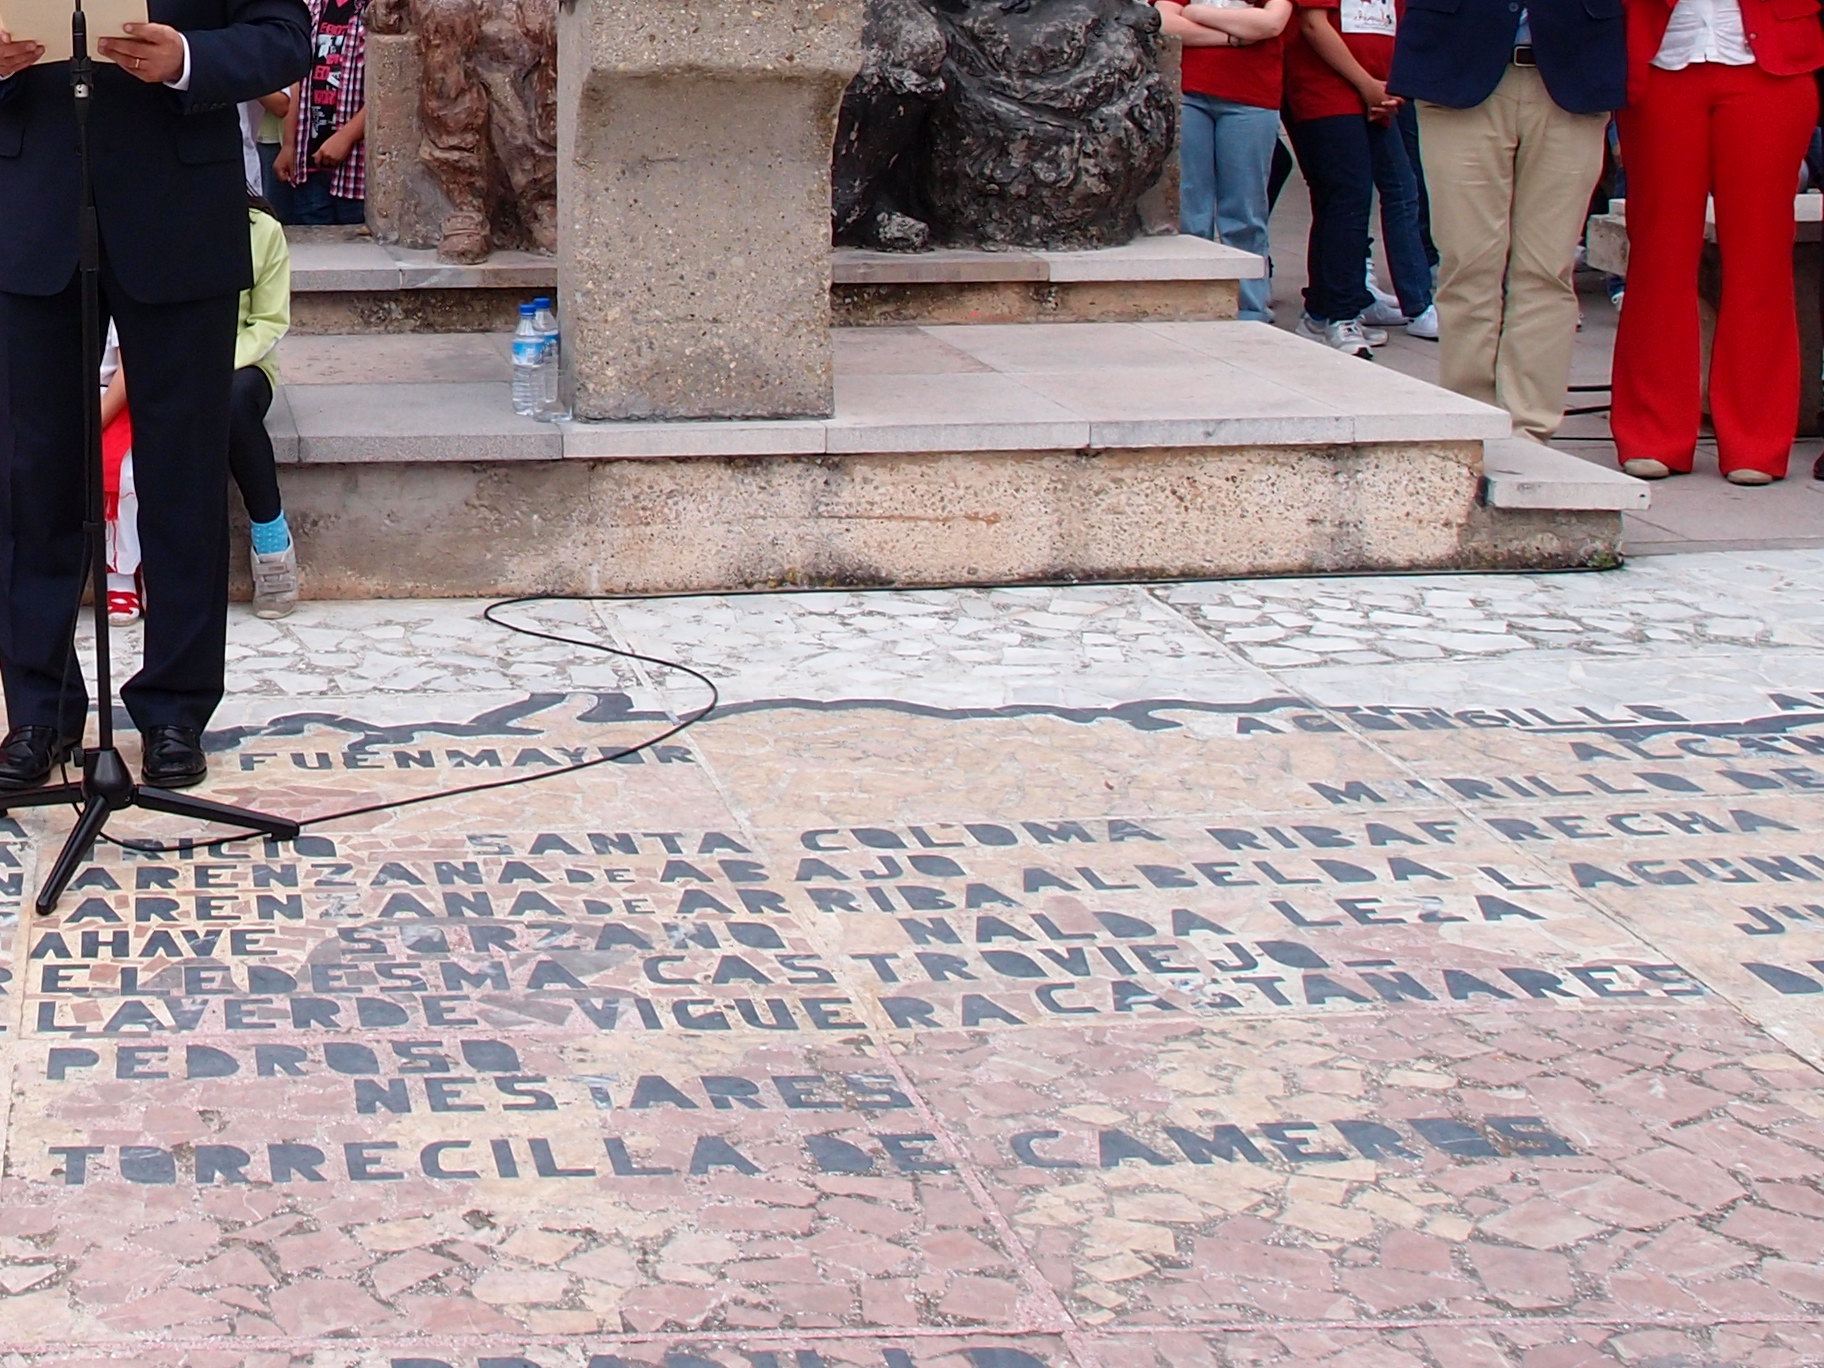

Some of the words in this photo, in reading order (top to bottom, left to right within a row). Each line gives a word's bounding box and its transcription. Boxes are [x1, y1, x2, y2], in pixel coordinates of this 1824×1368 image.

[239, 744, 699, 773] FUENMAYOR
[466, 831, 751, 856] SANTA
[801, 818, 1166, 852] COLOMA
[67, 860, 550, 891] ARENZANA
[565, 867, 636, 883] DE
[660, 854, 967, 883] ABAJO
[1023, 856, 1452, 893] ALBELDA
[65, 888, 567, 923] ARENZANA
[582, 897, 656, 916] DE
[676, 882, 1023, 915] ARRIBA
[1270, 894, 1547, 928] LEZA
[338, 920, 790, 955] SORZANO
[898, 908, 1235, 945] NALDA
[119, 959, 589, 996] LEDESMA
[642, 939, 1331, 986] CASTROVIEJO
[576, 993, 1027, 1031] VIGUERA
[46, 1037, 522, 1080] PEDROSO
[48, 1135, 765, 1186] TORRECILLA
[804, 1132, 956, 1176] DE
[1007, 1116, 1577, 1170] CAMEROS
